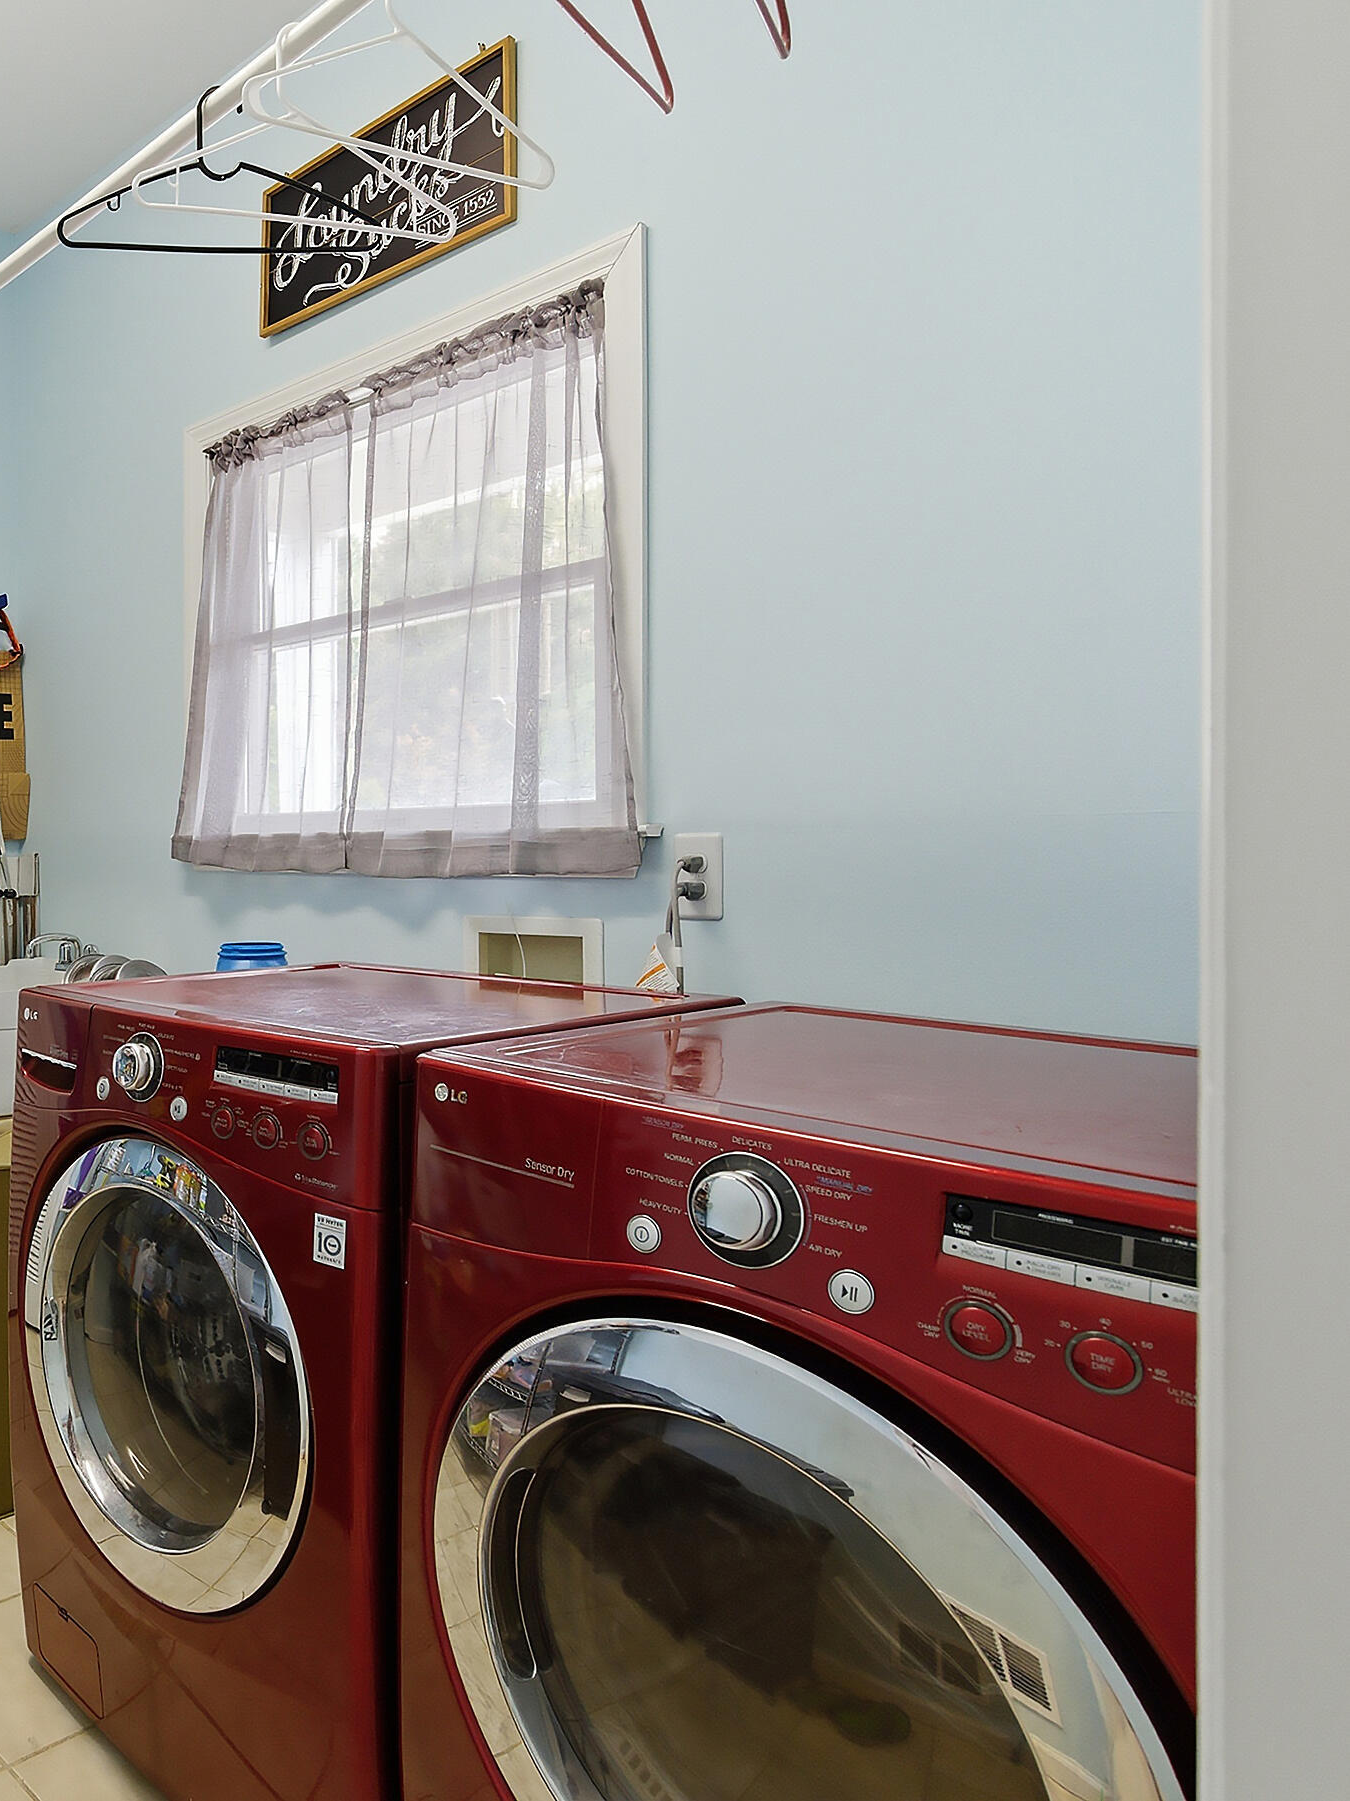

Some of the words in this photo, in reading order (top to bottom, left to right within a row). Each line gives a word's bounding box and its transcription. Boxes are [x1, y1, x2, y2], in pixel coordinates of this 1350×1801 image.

[416, 206, 462, 237] SINCE
[462, 187, 497, 217] 1552
[450, 1088, 468, 1104] LG
[695, 1137, 719, 1149] PRESS
[731, 1135, 773, 1150] DELICATES
[664, 1152, 695, 1166] NORMAL
[525, 1157, 556, 1174] Sensor
[557, 1166, 575, 1182] Dry
[783, 1157, 811, 1169] ULTRA
[812, 1163, 852, 1178] DELICATE
[805, 1184, 832, 1197] SPEED
[833, 1191, 853, 1201] DRY
[639, 1198, 662, 1209] HEAVY
[661, 1204, 682, 1215] DUTY
[813, 1213, 854, 1229] FRESHEN
[854, 1223, 868, 1232] UP
[808, 1243, 823, 1254] AIR
[824, 1247, 843, 1258] DRY
[962, 1284, 998, 1299] NORMAL
[966, 1322, 987, 1332] DRY
[1058, 1320, 1071, 1329] 30
[923, 1330, 940, 1339] DRY
[962, 1330, 992, 1342] LEVEL
[1140, 1340, 1154, 1350] 50
[1090, 1352, 1116, 1366] TIME
[1091, 1362, 1113, 1374] DRY
[1154, 1367, 1168, 1377] 60
